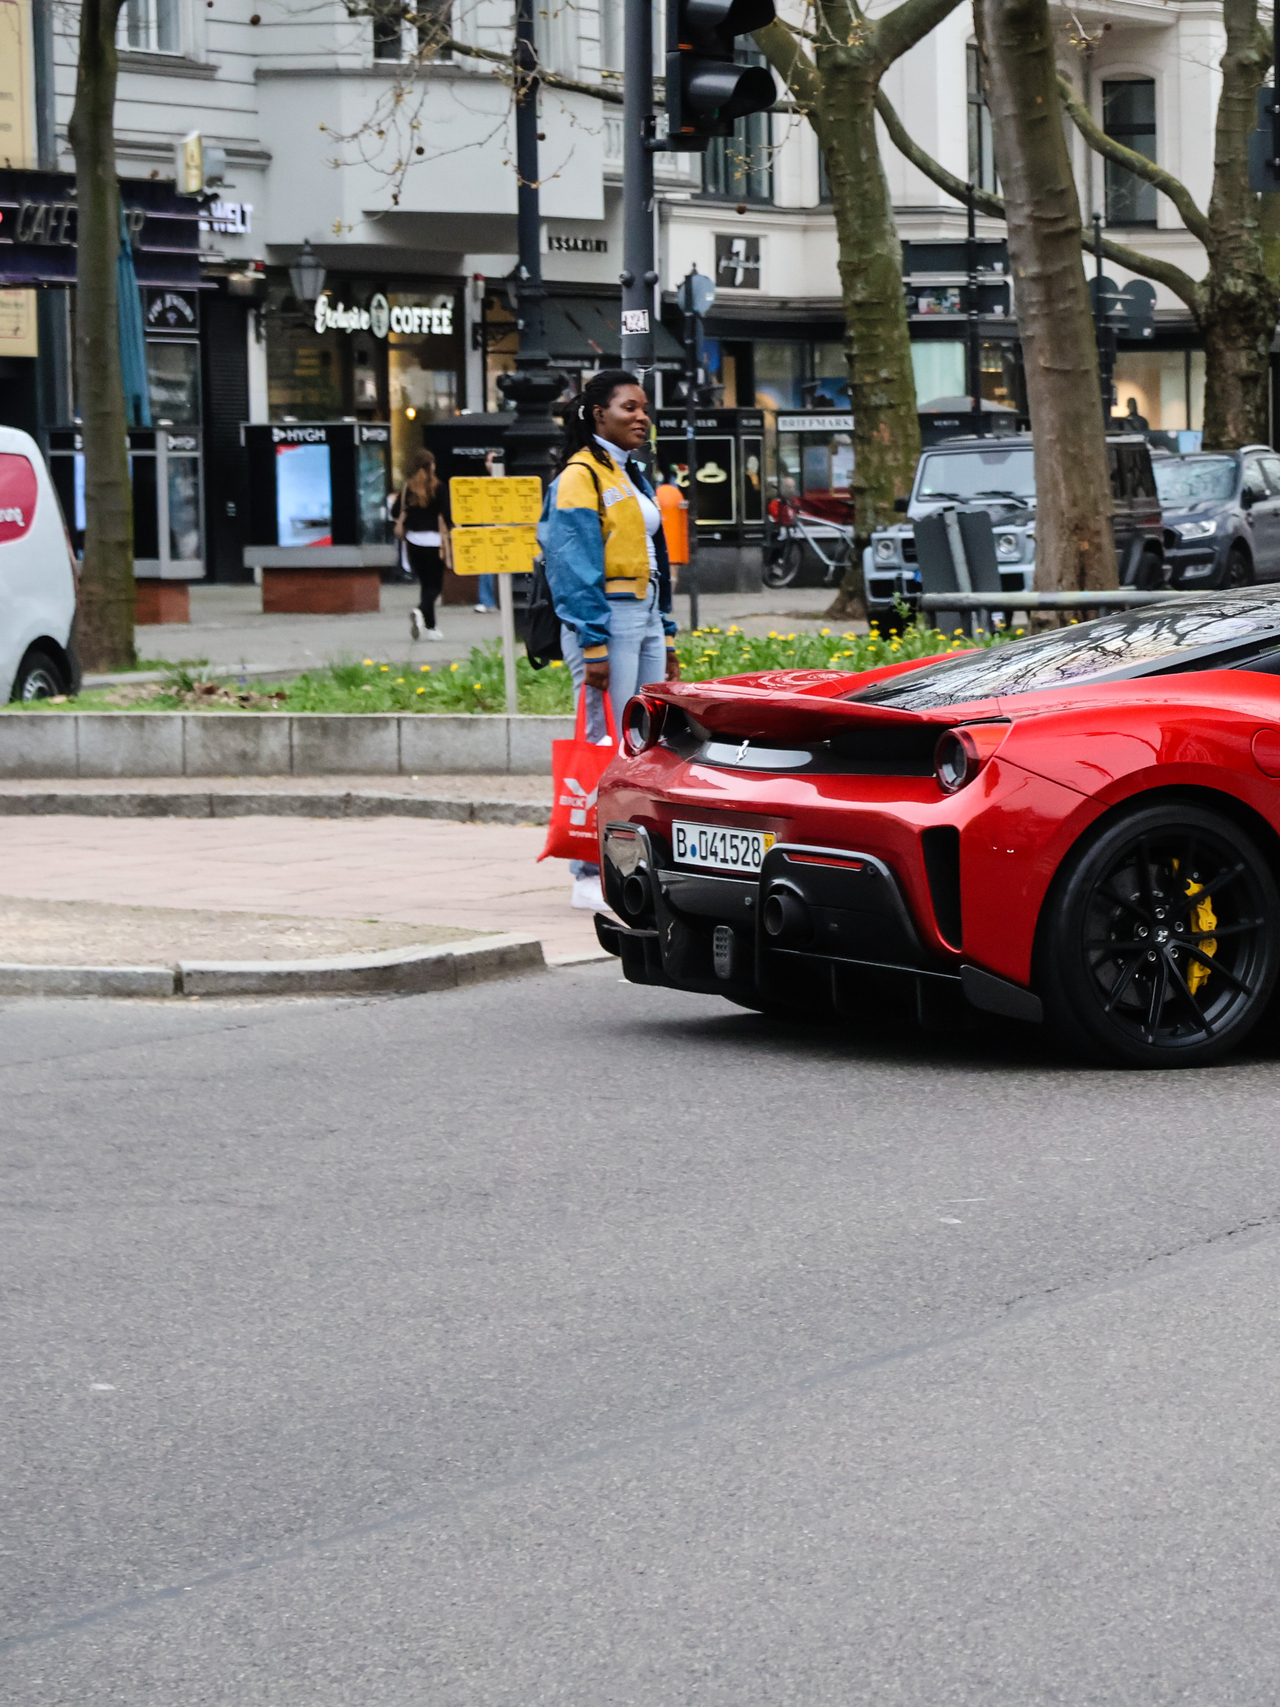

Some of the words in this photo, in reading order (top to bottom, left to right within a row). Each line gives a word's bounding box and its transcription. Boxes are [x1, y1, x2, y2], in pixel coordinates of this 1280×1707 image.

[390, 305, 453, 335] COFFEE
[287, 429, 326, 442] HYGH
[676, 827, 687, 857] B
[699, 830, 762, 868] 041528
